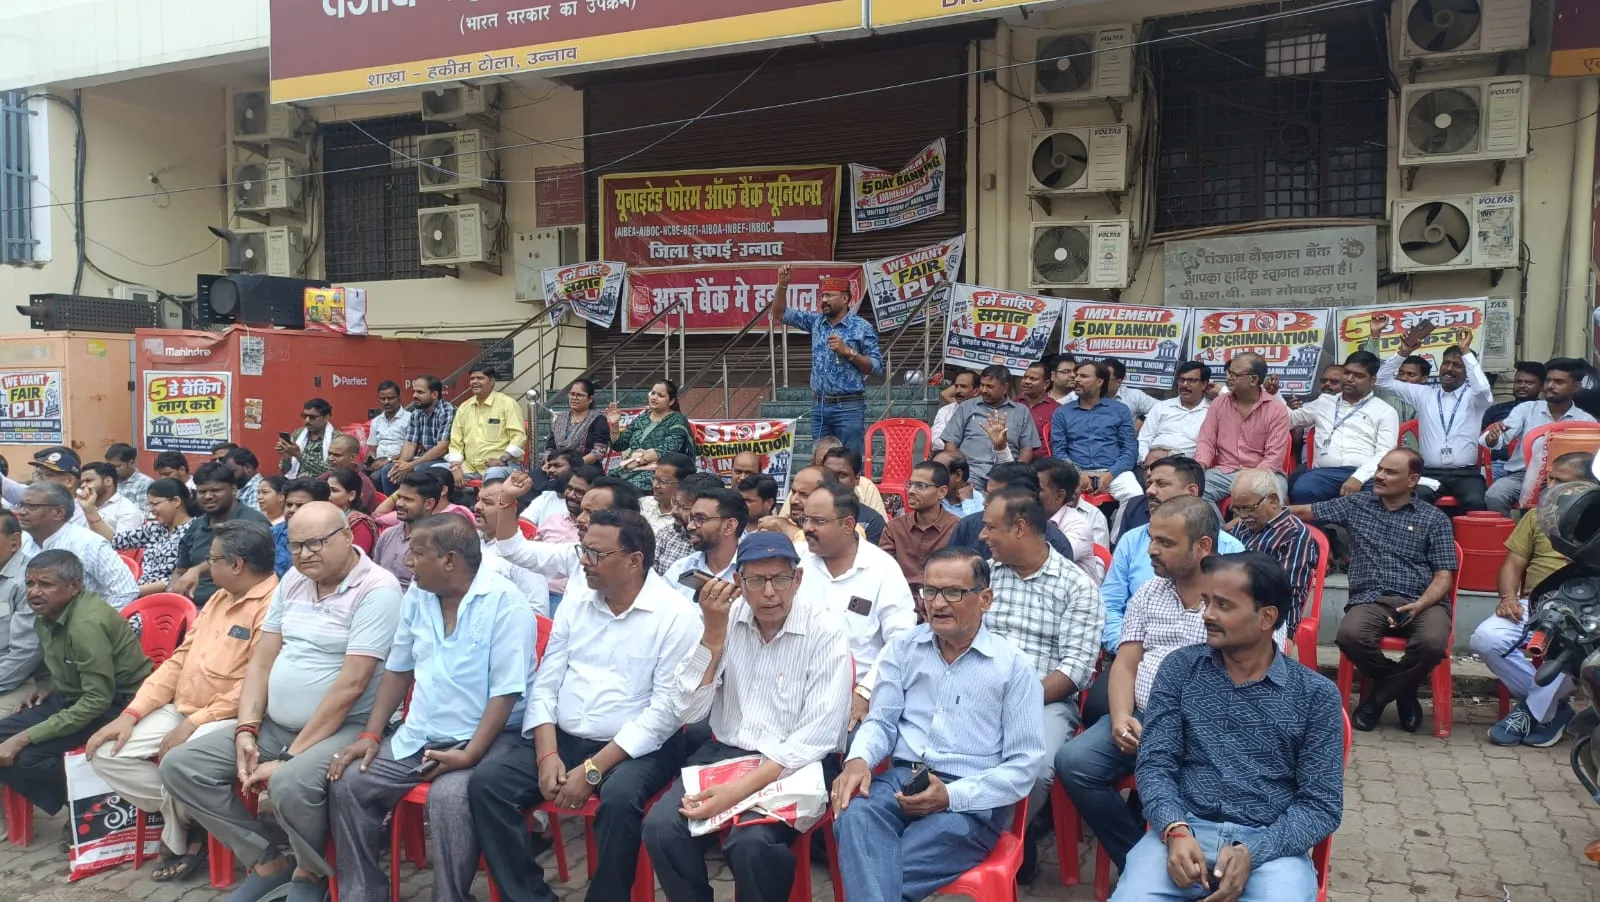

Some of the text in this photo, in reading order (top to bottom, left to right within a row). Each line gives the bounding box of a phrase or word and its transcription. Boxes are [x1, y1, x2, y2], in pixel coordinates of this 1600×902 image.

[460, 13, 499, 35] (भारत
[506, 5, 551, 25] सरकार
[559, 1, 577, 17] का
[367, 71, 406, 88] शाखा
[427, 59, 472, 81] हकीम
[478, 54, 521, 72] टोला,
[527, 45, 578, 66] उन्नाव
[1094, 127, 1122, 136] VOLTAS
[862, 180, 874, 195] 5
[875, 177, 895, 191] DAY
[615, 180, 664, 222] यूनाइटेड
[665, 179, 702, 212] फोरम
[705, 177, 738, 210] ऑफ
[739, 175, 765, 208] बैंक
[766, 174, 824, 217] यूनियन्स
[1479, 195, 1514, 205] VOLTAS
[1098, 231, 1121, 239] VOLTAS
[649, 241, 689, 259] जिला
[1306, 242, 1331, 258] बैंक
[886, 247, 943, 273] WE WANT
[898, 260, 941, 284] FAIR
[1303, 264, 1335, 276] करता
[652, 286, 694, 315] आज
[695, 276, 730, 314] बैंक
[977, 292, 1000, 308] हमें
[1000, 296, 1036, 311] चाहिए
[977, 309, 1033, 325] समान
[1084, 308, 1165, 322] IMPLEMENT
[980, 323, 1019, 340] PLI
[1072, 321, 1177, 338] 5 DAY BANKING
[1345, 314, 1373, 340] 5
[1089, 338, 1157, 351] IMMEDIATELY
[1201, 329, 1319, 349] DISCRIMINATION
[1125, 360, 1142, 369] BANK
[1144, 362, 1165, 370] UNION
[1286, 367, 1308, 376] UNION
[5, 375, 45, 389] WE WANT
[341, 376, 368, 386] Perfect
[10, 387, 41, 402] FAIR
[150, 379, 168, 401] 5
[168, 379, 180, 397] डे
[12, 399, 41, 418] PLI
[157, 396, 217, 414] लागू करो
